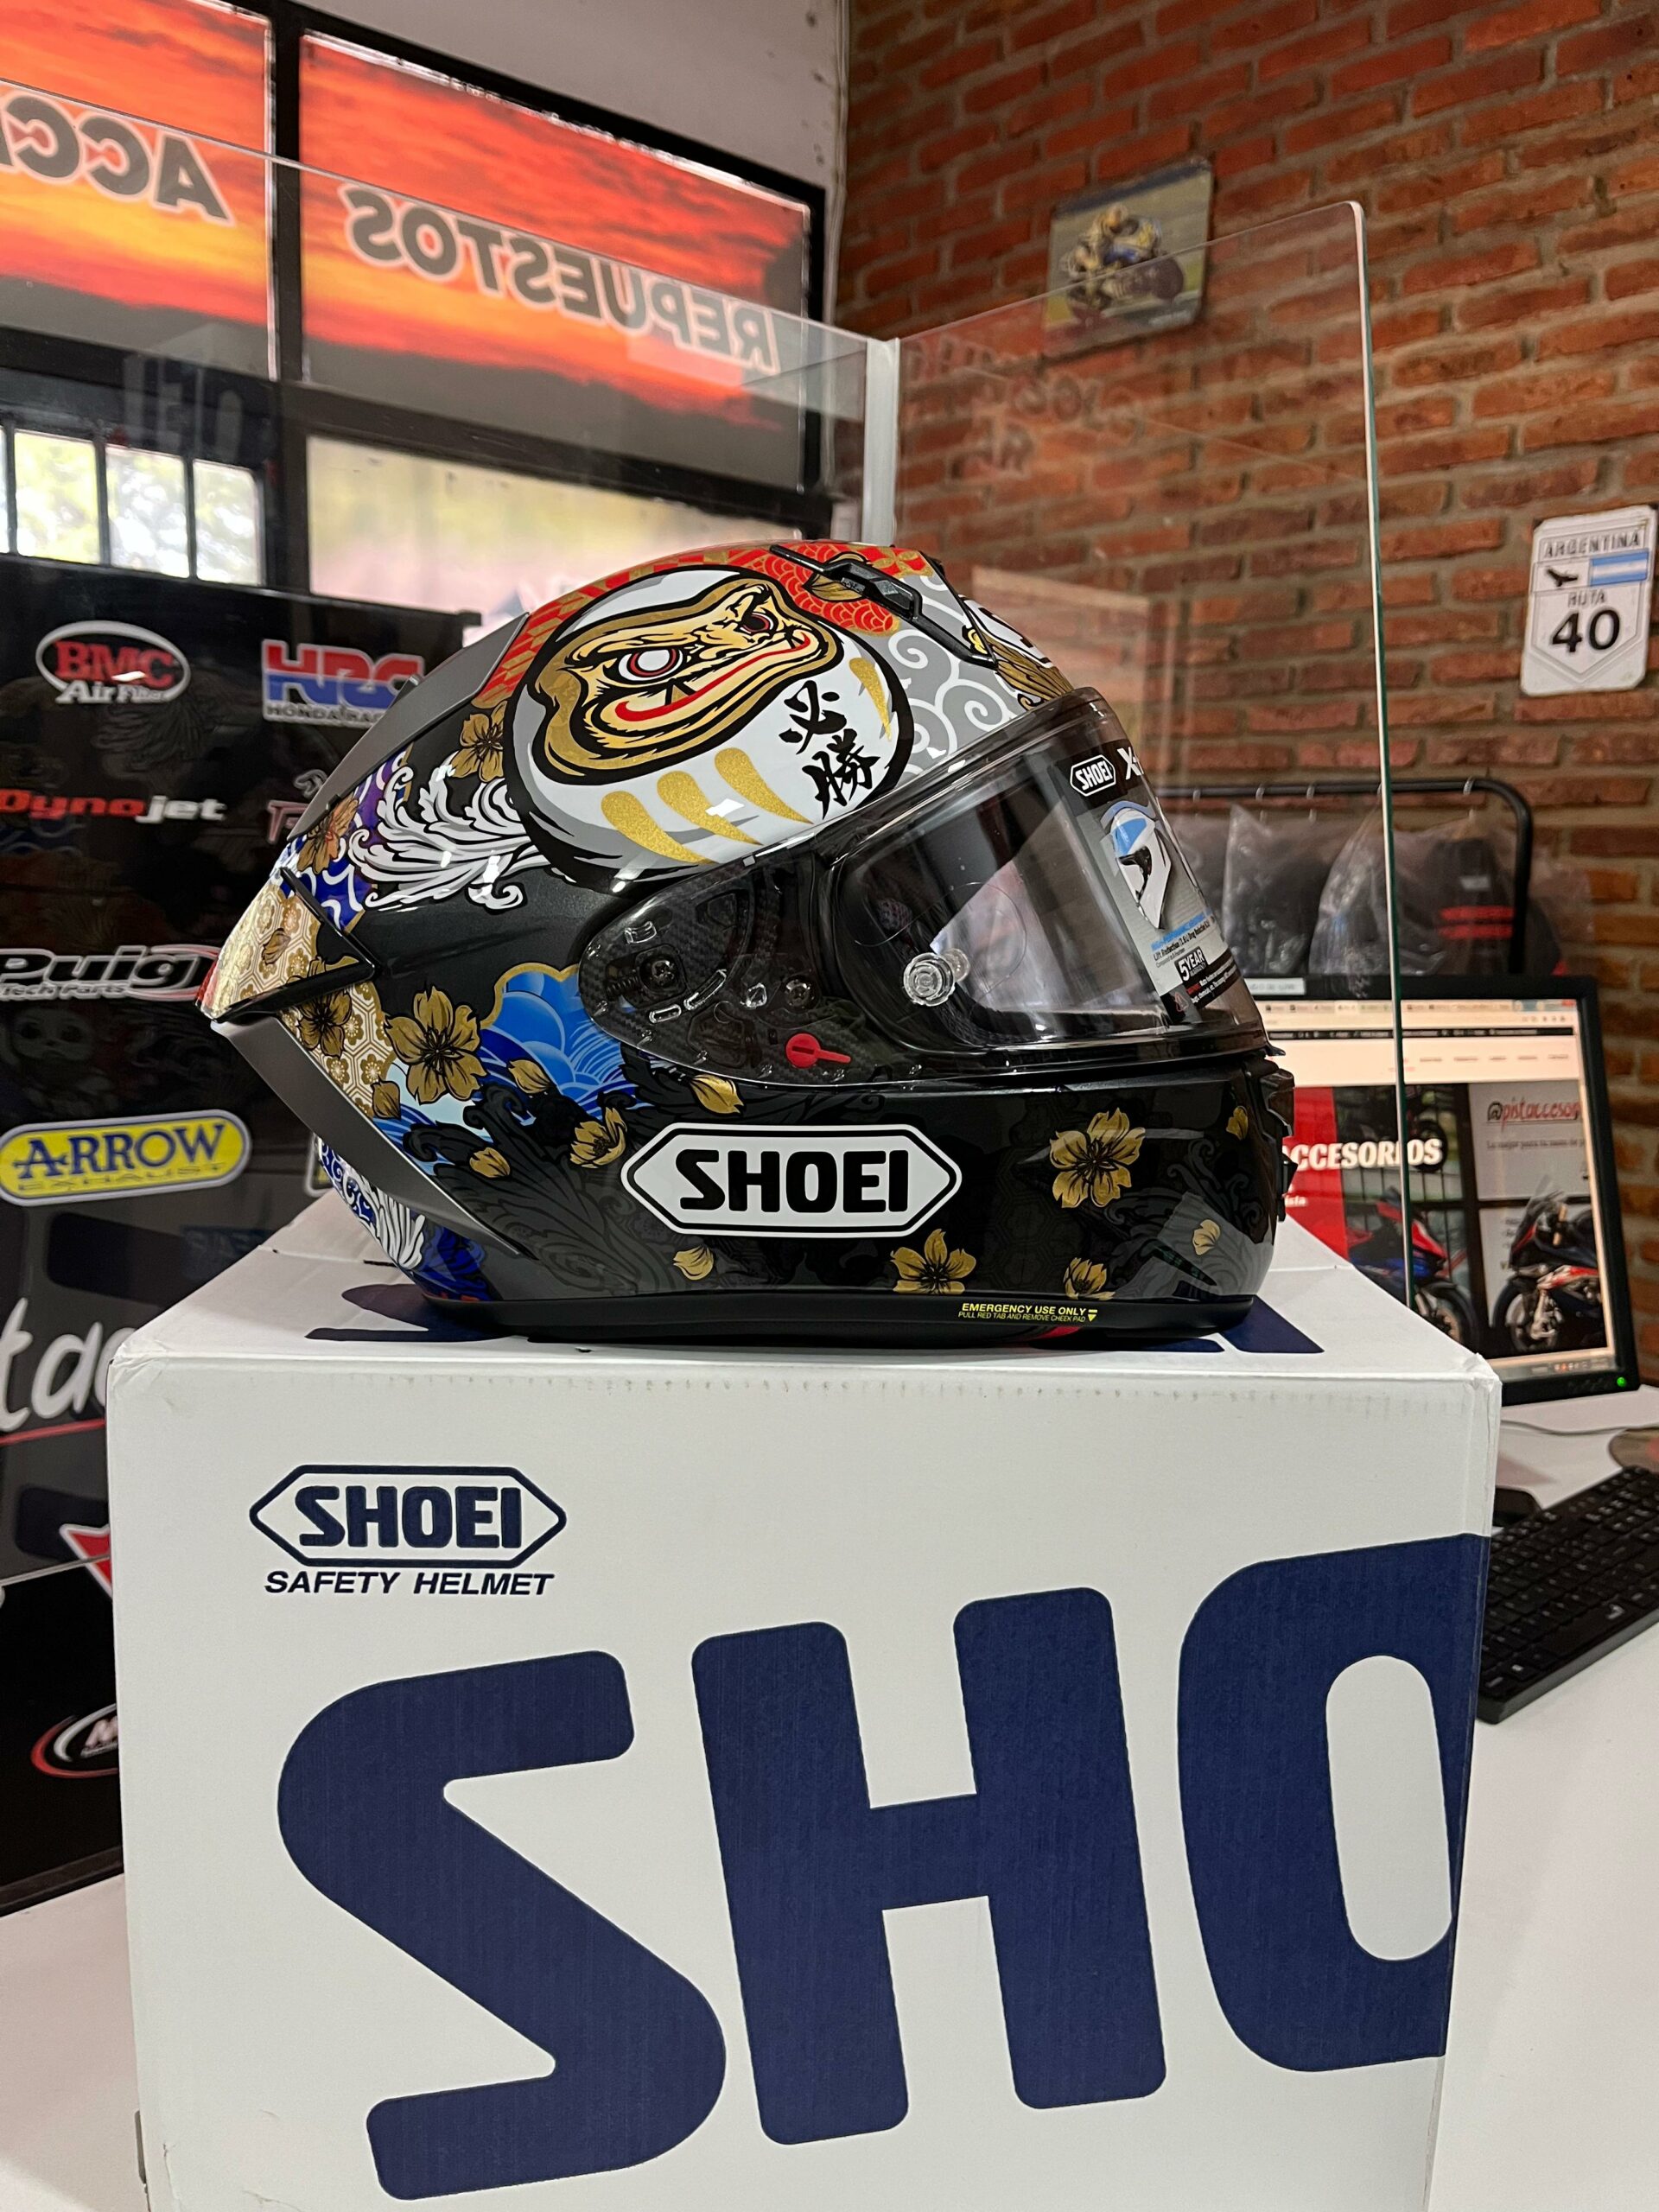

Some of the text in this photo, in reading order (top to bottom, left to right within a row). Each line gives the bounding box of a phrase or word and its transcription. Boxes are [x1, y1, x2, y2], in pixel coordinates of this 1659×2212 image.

[1543, 530, 1641, 558] ARGENTINA
[1567, 591, 1606, 608] RUTA
[1552, 609, 1620, 652] 40
[54, 639, 175, 689] BMC
[55, 680, 114, 703] Air
[267, 702, 340, 720] HONDA
[1075, 760, 1113, 791] SHOEI
[0, 787, 226, 824] Dynojet
[0, 945, 200, 990] Puig
[12, 1124, 226, 1179] ARROW
[18, 1161, 226, 1192] EXHAUST
[675, 1148, 909, 1213] SHOEI
[962, 1302, 1086, 1316] EMERGENCY USE ONLY
[294, 1484, 522, 1548] SHOEI
[264, 1570, 555, 1595] SAFETY HELMET
